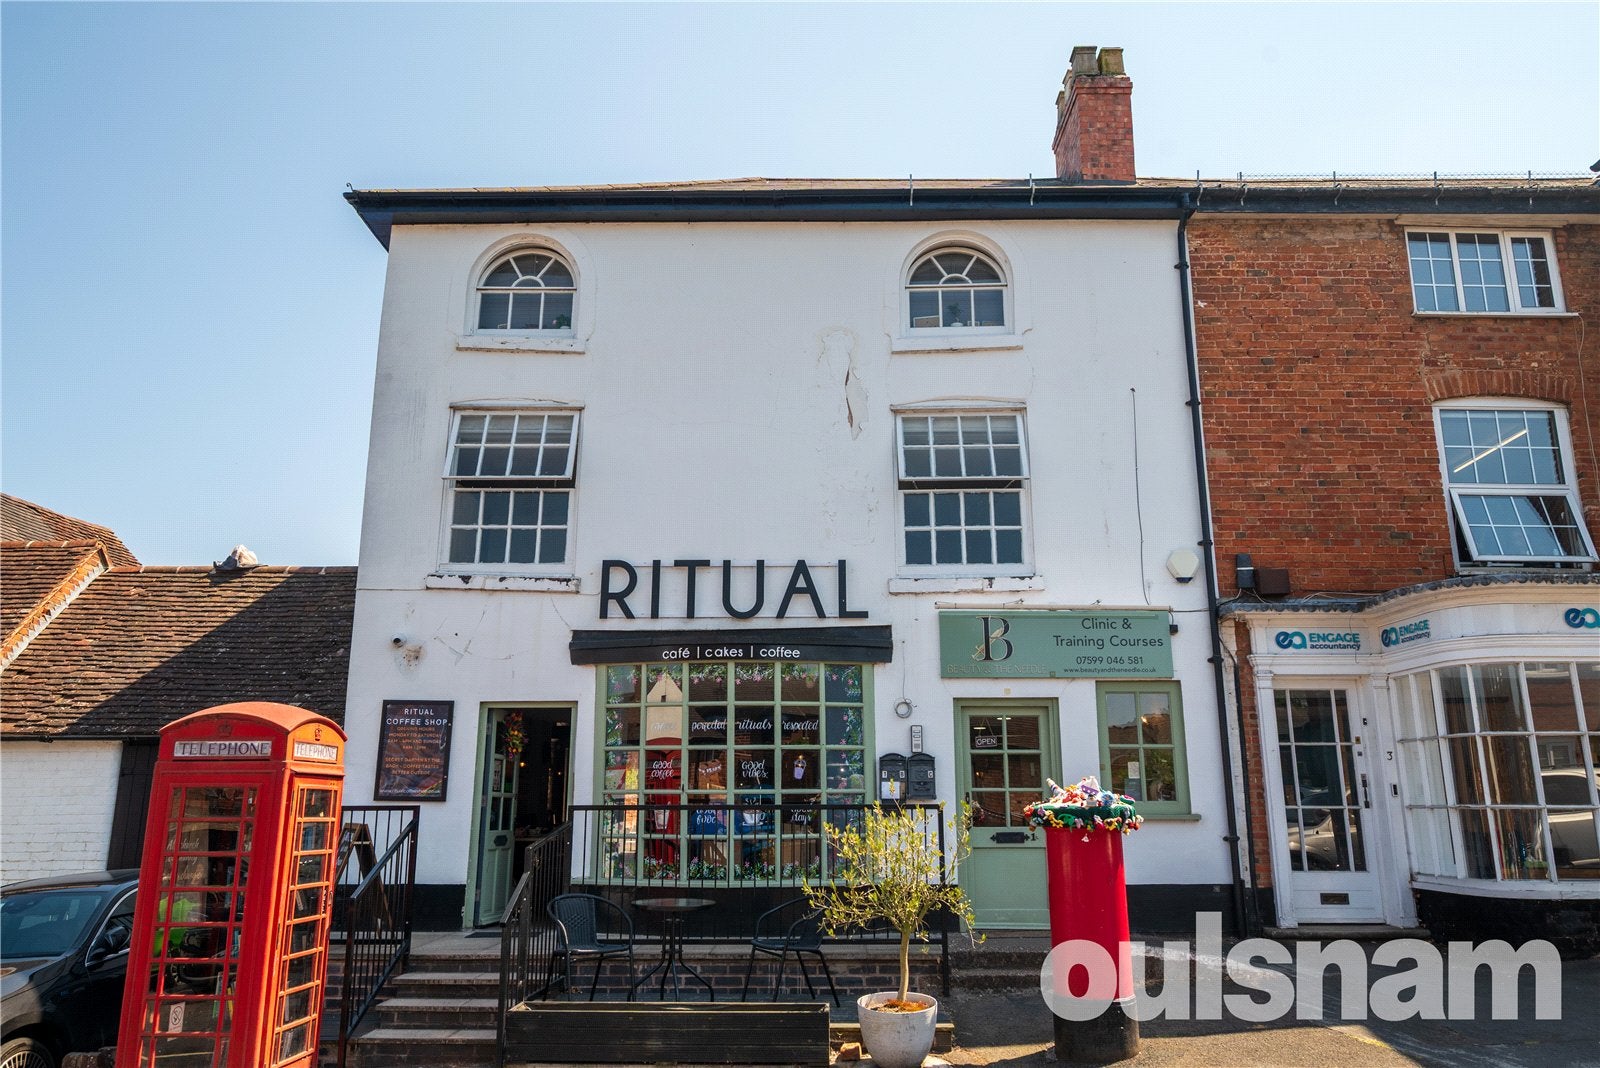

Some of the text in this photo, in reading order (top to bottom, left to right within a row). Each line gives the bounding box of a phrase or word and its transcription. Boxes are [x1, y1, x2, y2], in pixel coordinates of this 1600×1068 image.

[600, 559, 869, 619] RITUAL
[1081, 618, 1132, 630] Clinic &
[1399, 619, 1430, 636] ENGAGE
[1053, 635, 1164, 649] Training Courses
[1309, 632, 1360, 643] ENGAGE
[1401, 631, 1431, 643] accountancy
[662, 646, 801, 660] café cakes coffee
[1309, 643, 1361, 651] accountancy
[1076, 656, 1144, 664] 07599 046 581
[404, 708, 435, 716] RITUAL
[386, 718, 448, 726] COFFEE SHOP
[692, 718, 727, 732] perfected
[736, 718, 772, 730] rituals
[782, 719, 819, 732] respected
[976, 738, 996, 746] OPEN
[180, 742, 270, 756] TELEPHONE
[296, 742, 336, 760] TELEPHONE
[1386, 751, 1393, 760] 3
[651, 768, 674, 780] coffee
